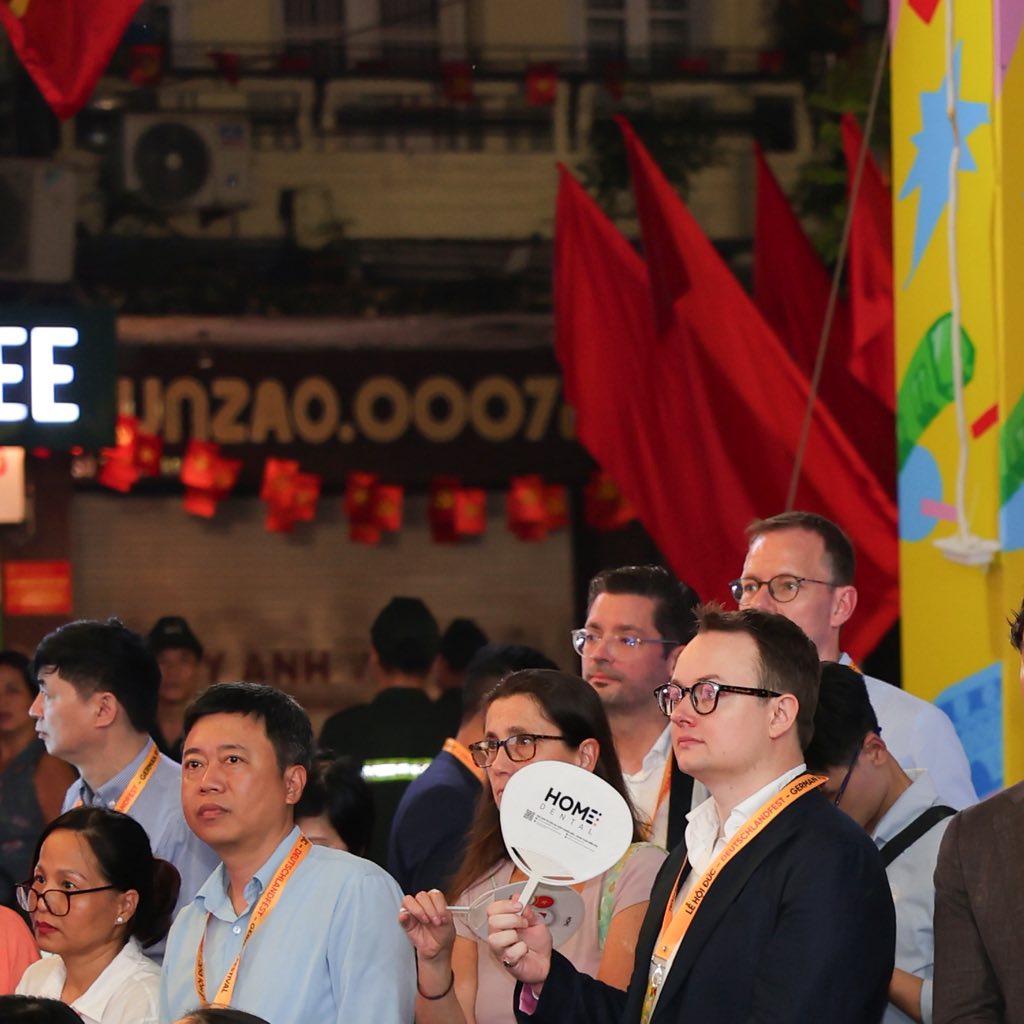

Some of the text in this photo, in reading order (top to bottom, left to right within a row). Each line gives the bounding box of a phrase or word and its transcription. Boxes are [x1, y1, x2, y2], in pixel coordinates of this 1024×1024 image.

[544, 787, 599, 826] HOME
[694, 887, 707, 905] HỘI
[702, 869, 717, 886] ĐỨC
[720, 797, 786, 862] DEUTSCHLANDFEST
[789, 776, 819, 796] GERMAN
[257, 847, 303, 918] DEUTSCHLANDFEST
